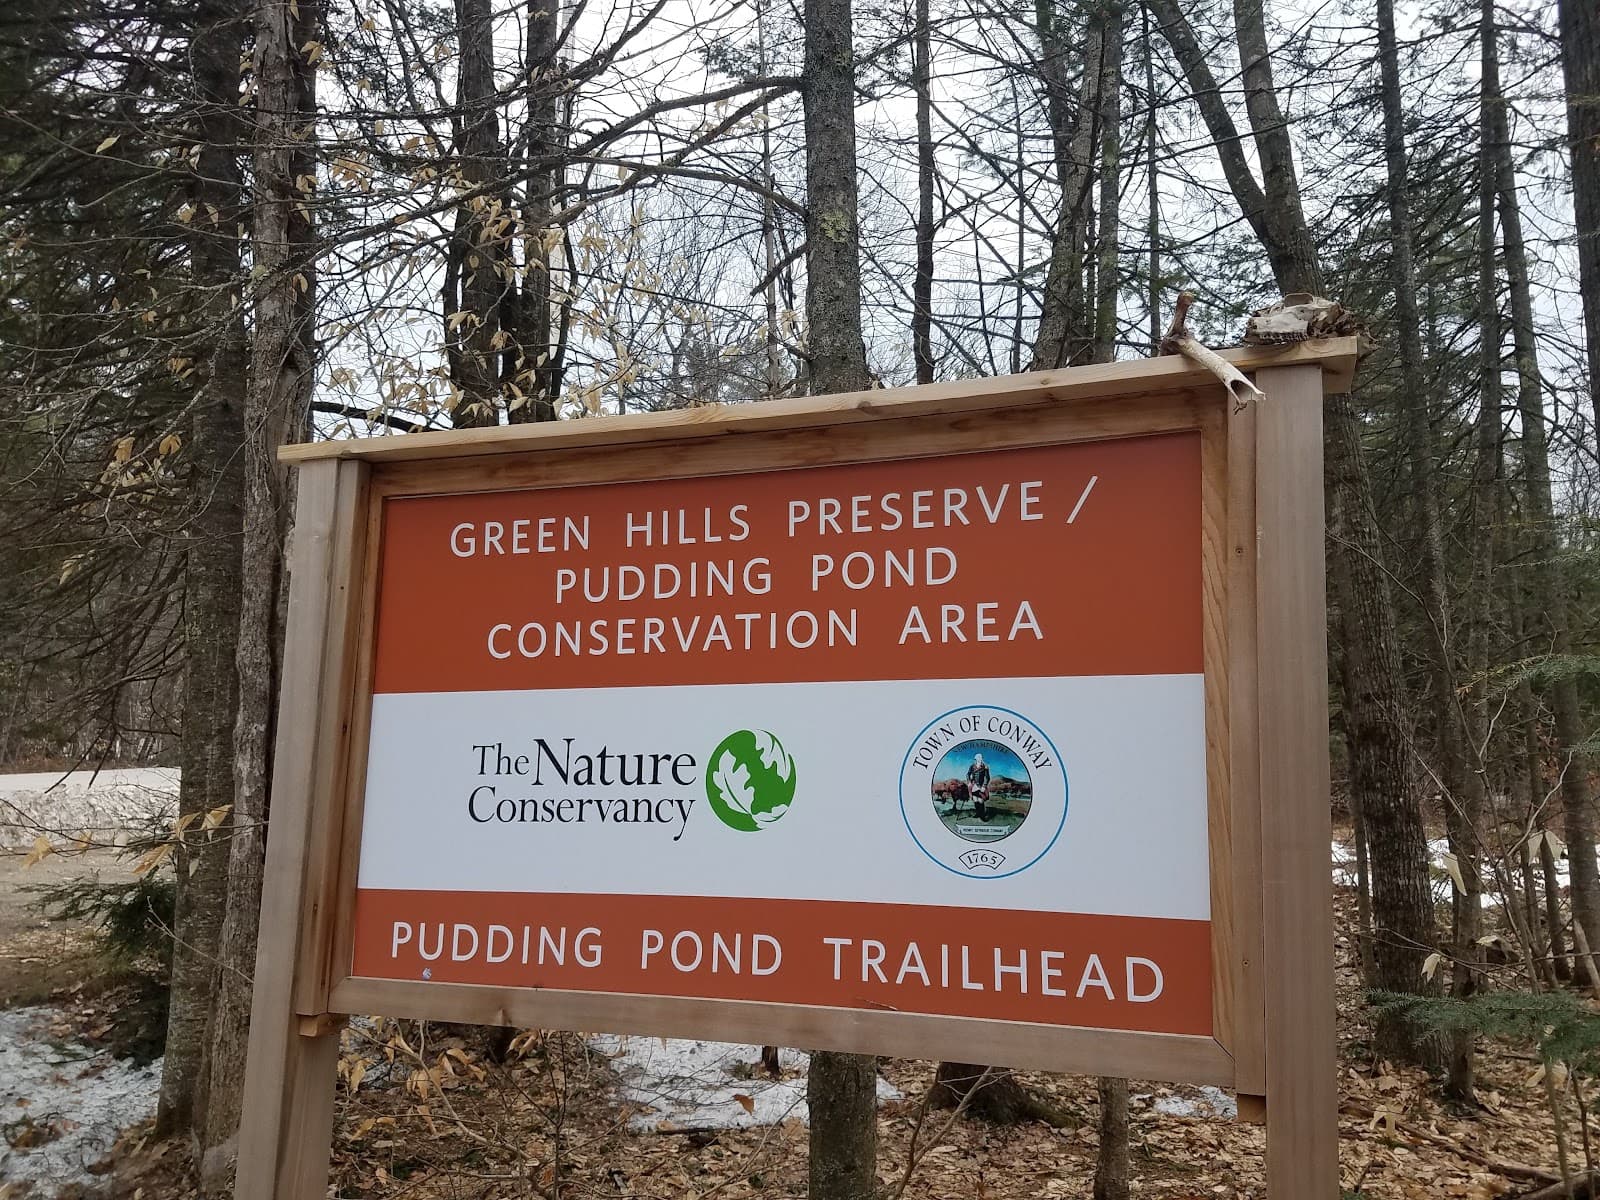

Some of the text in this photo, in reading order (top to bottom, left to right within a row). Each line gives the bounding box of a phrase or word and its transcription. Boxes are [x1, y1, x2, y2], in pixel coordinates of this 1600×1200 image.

[450, 475, 1098, 558] GREEN HILLS PRESERVE /
[556, 546, 958, 604] PUDDING POND
[487, 600, 1044, 659] CONSERVATION AREA
[472, 737, 697, 786] The Nature
[913, 715, 1052, 770] TOWN OF CONWAY
[468, 785, 697, 842] Conservancy
[966, 852, 998, 866] 1765
[391, 921, 1165, 1003] PUDDING POND TRAILHEAD
